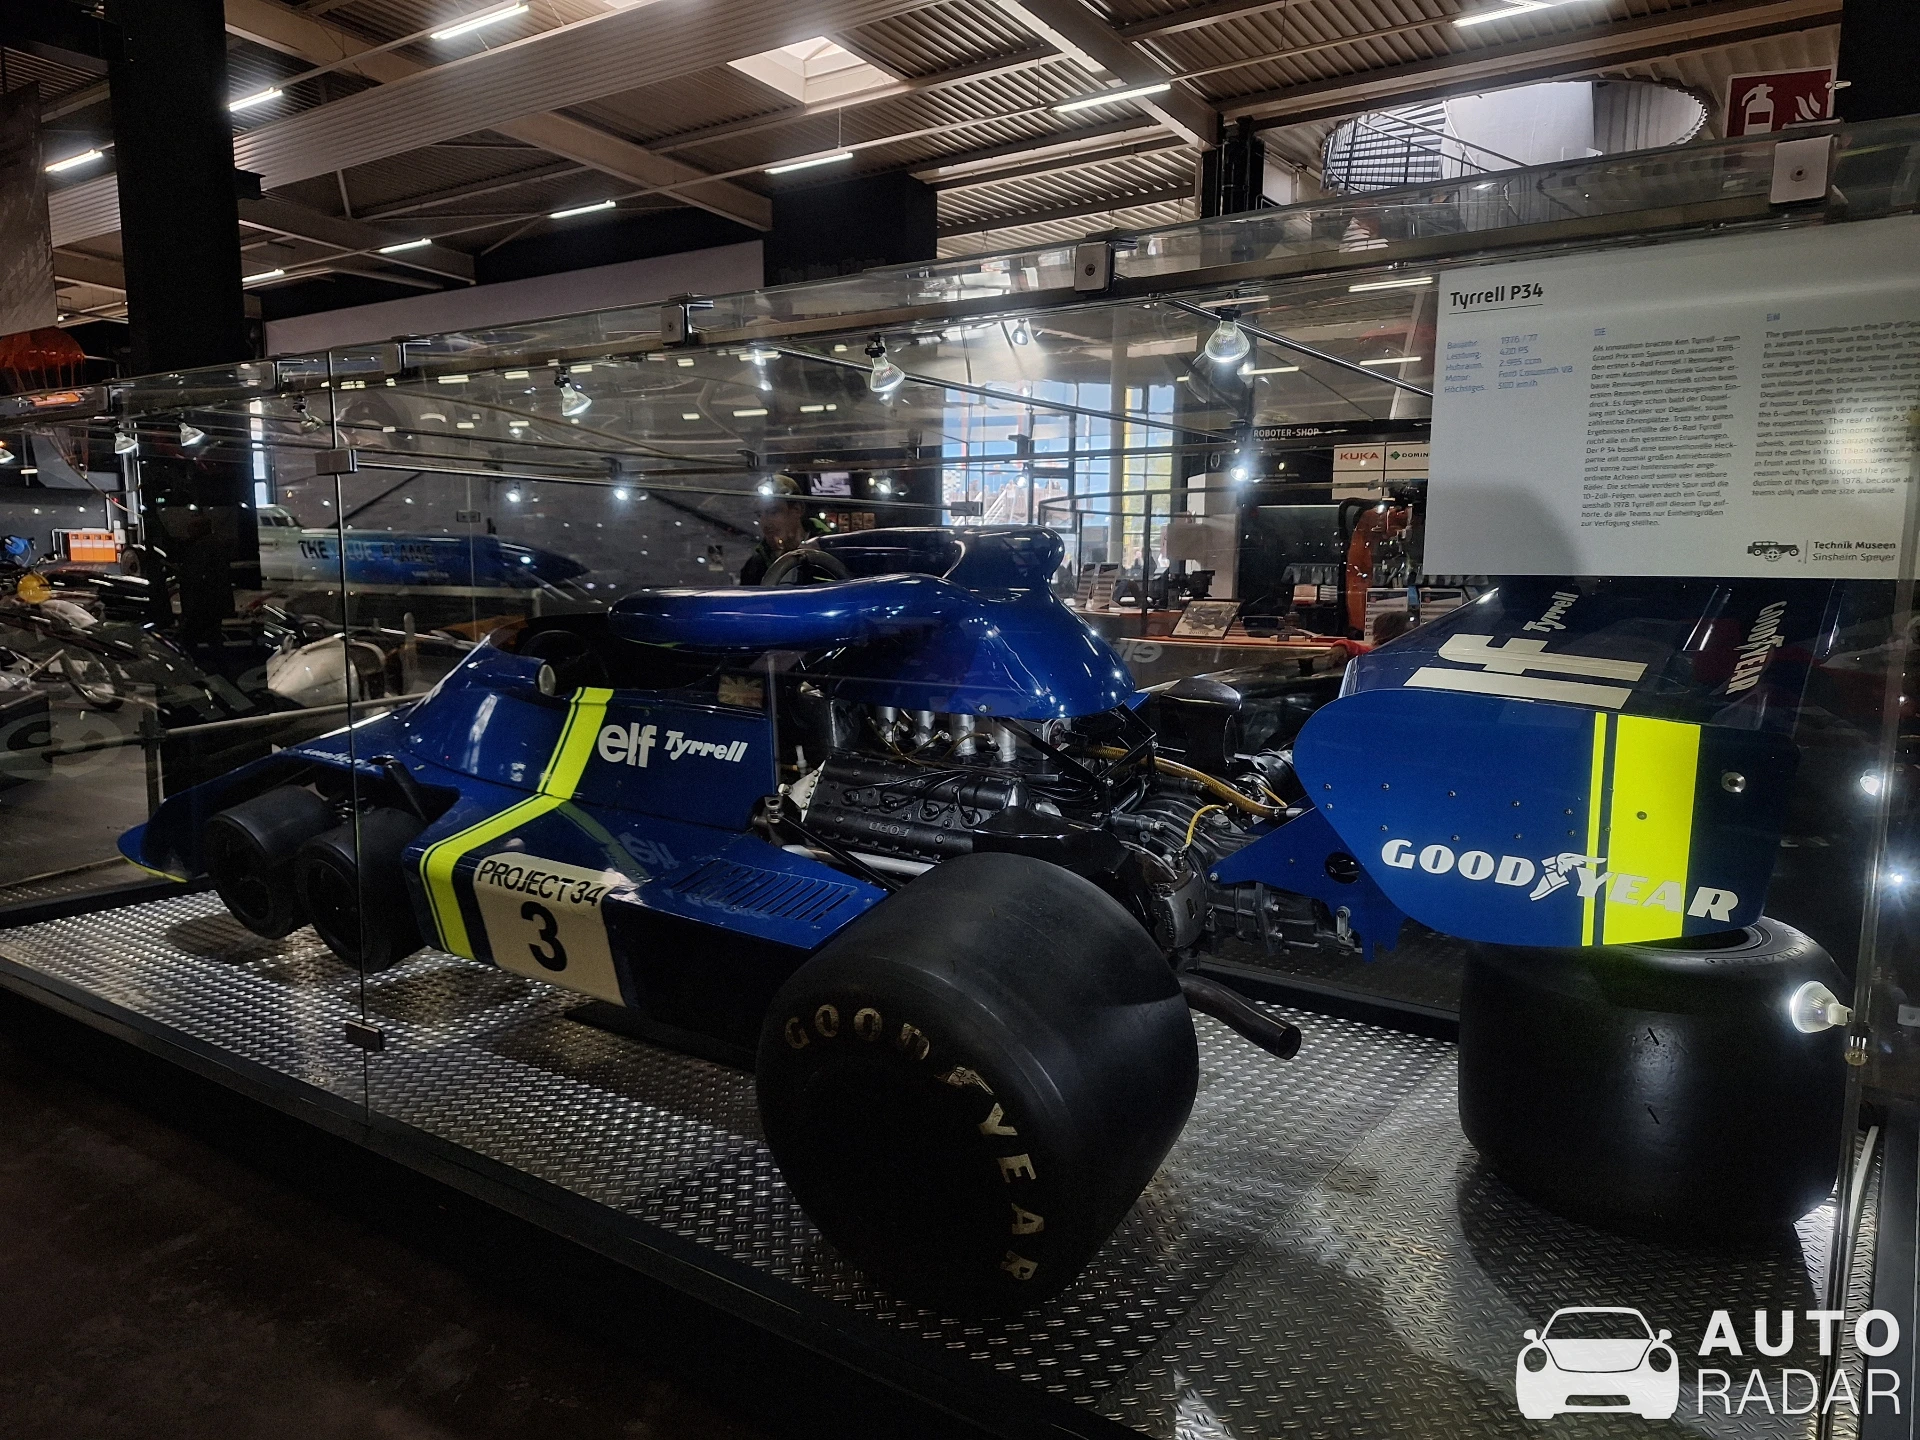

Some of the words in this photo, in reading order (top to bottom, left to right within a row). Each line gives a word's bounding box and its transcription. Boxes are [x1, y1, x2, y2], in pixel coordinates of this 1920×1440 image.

[1450, 286, 1505, 309] Tyrrell
[1511, 283, 1543, 300] P34
[1253, 427, 1319, 438] ROBOTER-SHOP
[1339, 452, 1379, 460] KUKA
[298, 540, 330, 559] THE
[1812, 553, 1857, 561] Sinsheim
[1860, 553, 1896, 563] Speyer
[1813, 541, 1852, 549] Technik
[1855, 541, 1896, 549] Museen
[1522, 591, 1579, 633] Tyrrell
[1725, 600, 1787, 695] GOODYEAR
[598, 722, 658, 768] elf
[664, 730, 748, 762] Tyrrell
[478, 859, 576, 902] PROJECT
[571, 881, 607, 907] 34
[1380, 839, 1739, 922] GOODYEAR
[520, 901, 567, 972] 3
